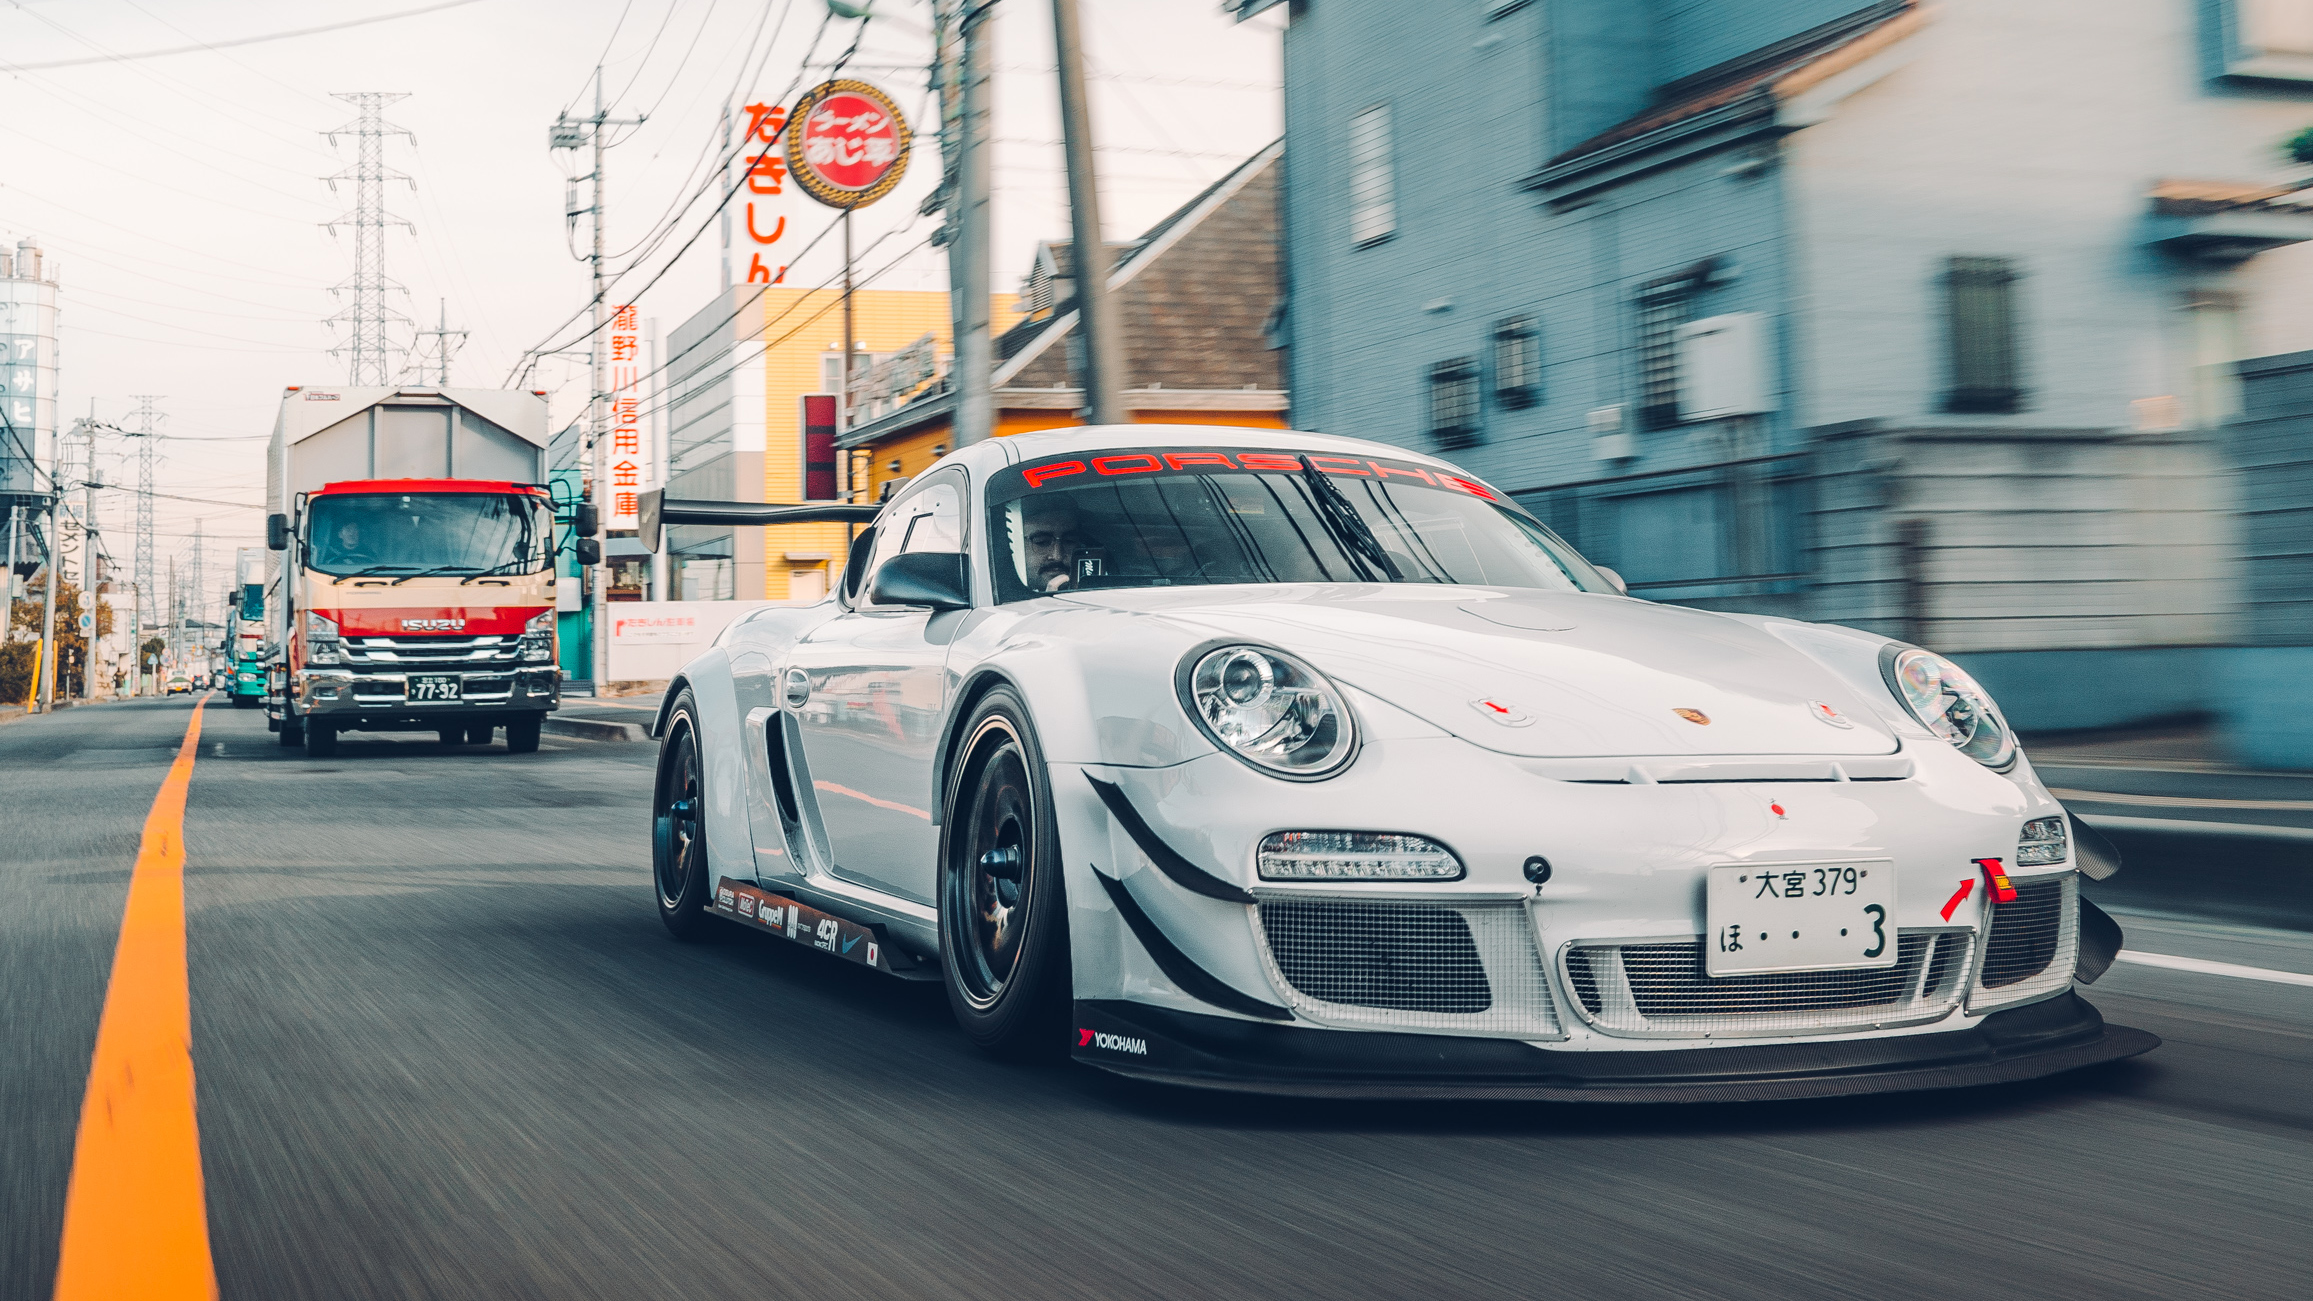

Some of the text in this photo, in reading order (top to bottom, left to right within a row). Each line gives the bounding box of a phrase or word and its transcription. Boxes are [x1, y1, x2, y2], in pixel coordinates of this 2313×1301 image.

[809, 109, 891, 135] ラーメン
[744, 102, 787, 284] たきしん
[13, 338, 35, 423] アサヒ
[611, 304, 639, 518] 瀧野川信用金庫
[1022, 452, 1499, 503] PORSCHE
[401, 618, 466, 631] ISUZU
[416, 682, 458, 700] 77-92
[1755, 866, 1858, 899] 大宮 379
[758, 898, 784, 927] GruppeM
[816, 918, 839, 953] 4CR
[1720, 924, 1744, 953] ほ
[1094, 1031, 1147, 1056] YOKOHAMA
